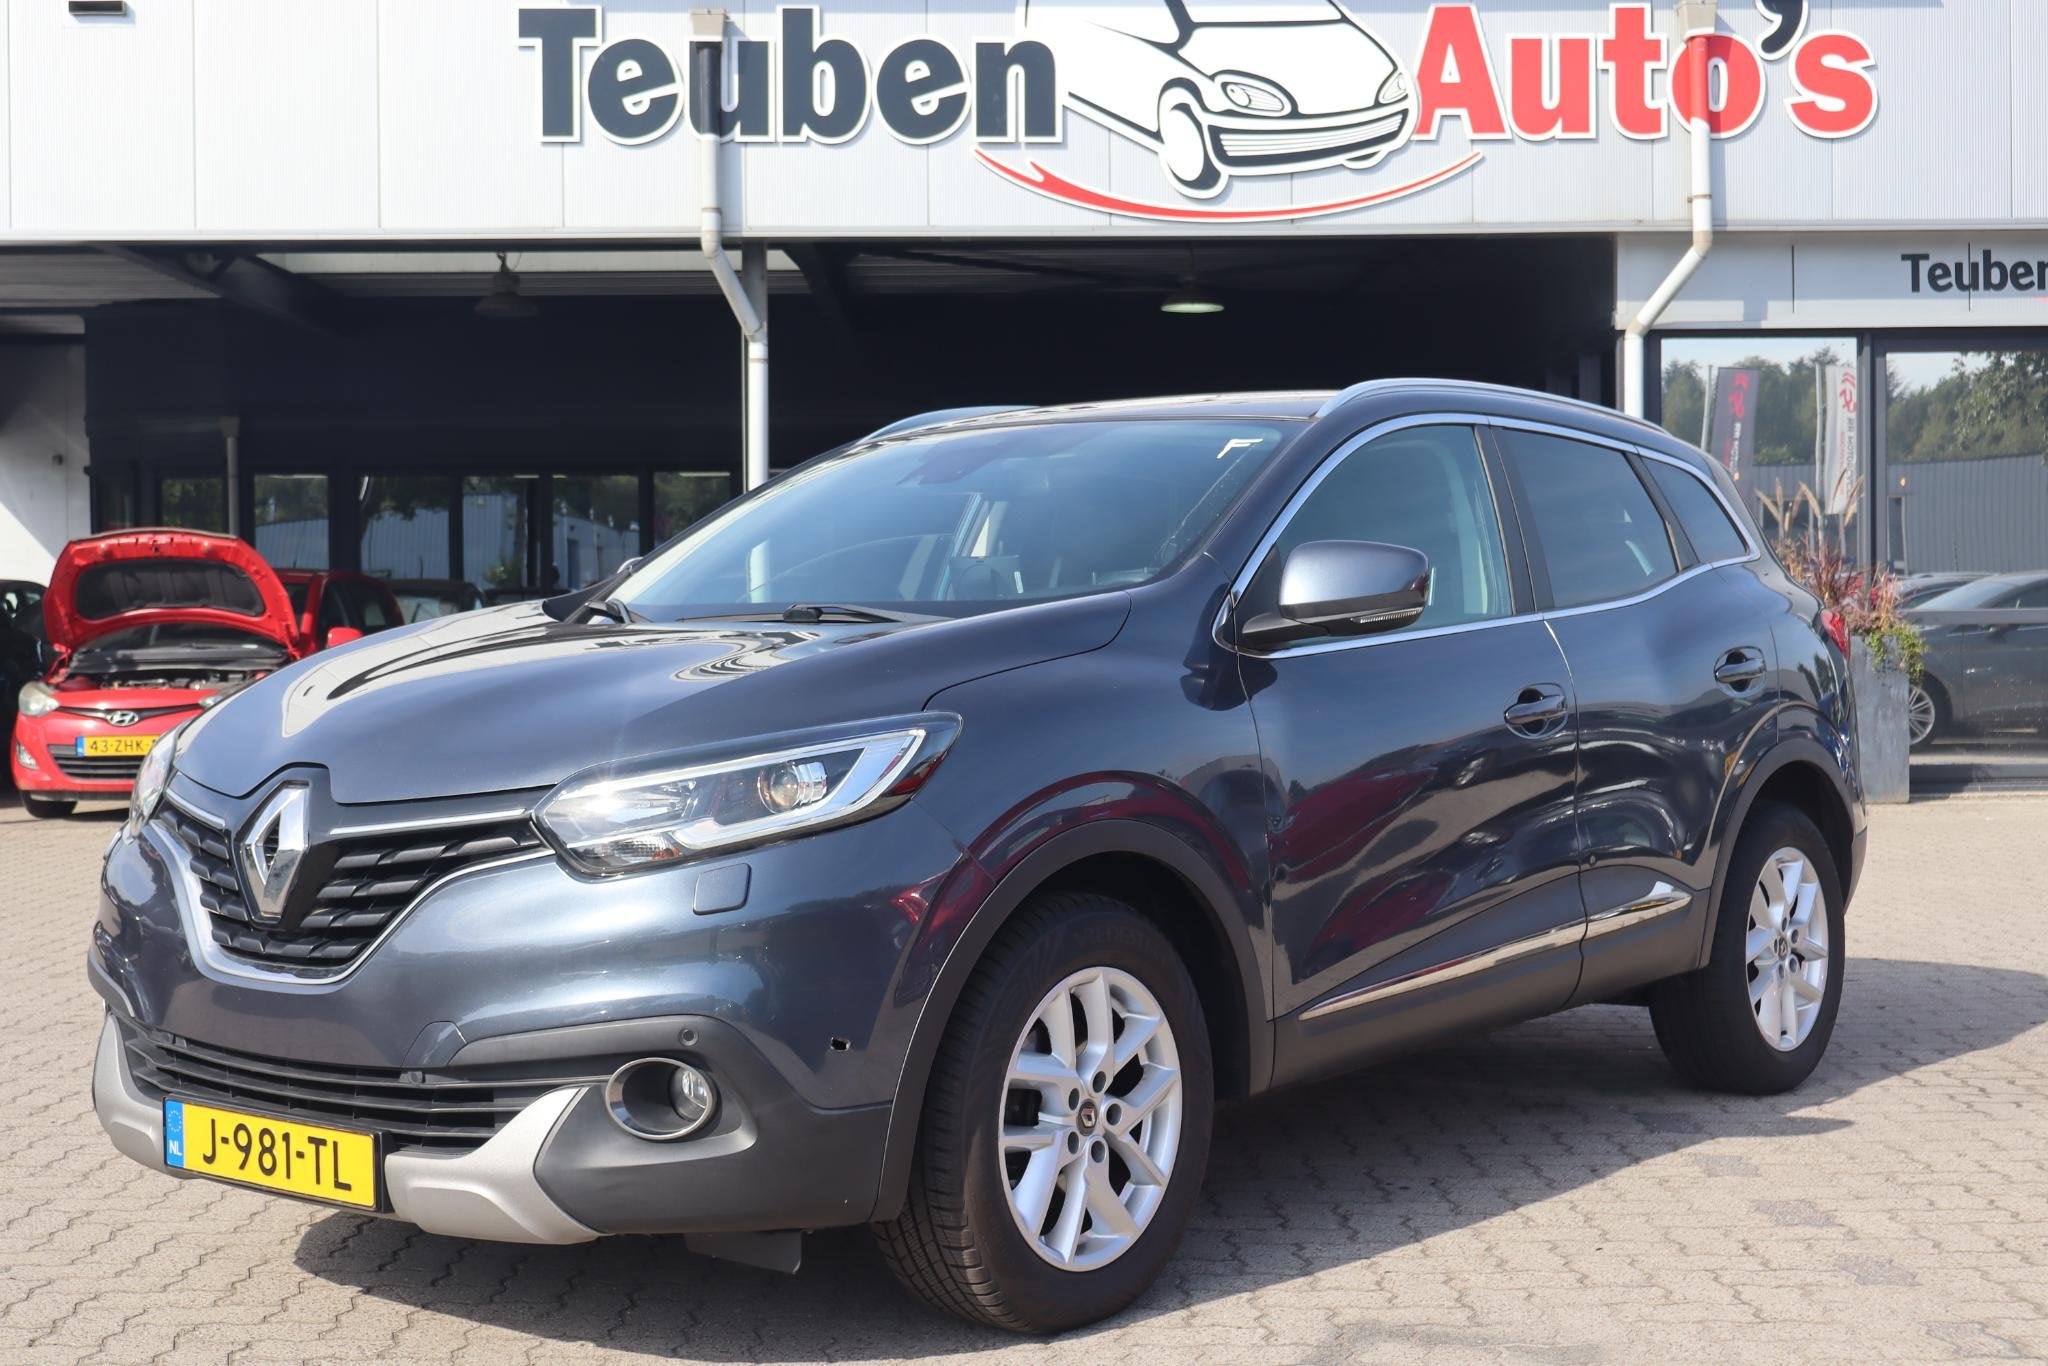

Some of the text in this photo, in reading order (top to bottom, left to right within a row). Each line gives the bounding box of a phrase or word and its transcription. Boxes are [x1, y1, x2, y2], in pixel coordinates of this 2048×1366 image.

[518, 0, 1874, 141] Teuben Auto's
[90, 740, 156, 753] 43-ZHK-
[169, 1140, 183, 1156] NL
[203, 1118, 352, 1191] J-981-TL
